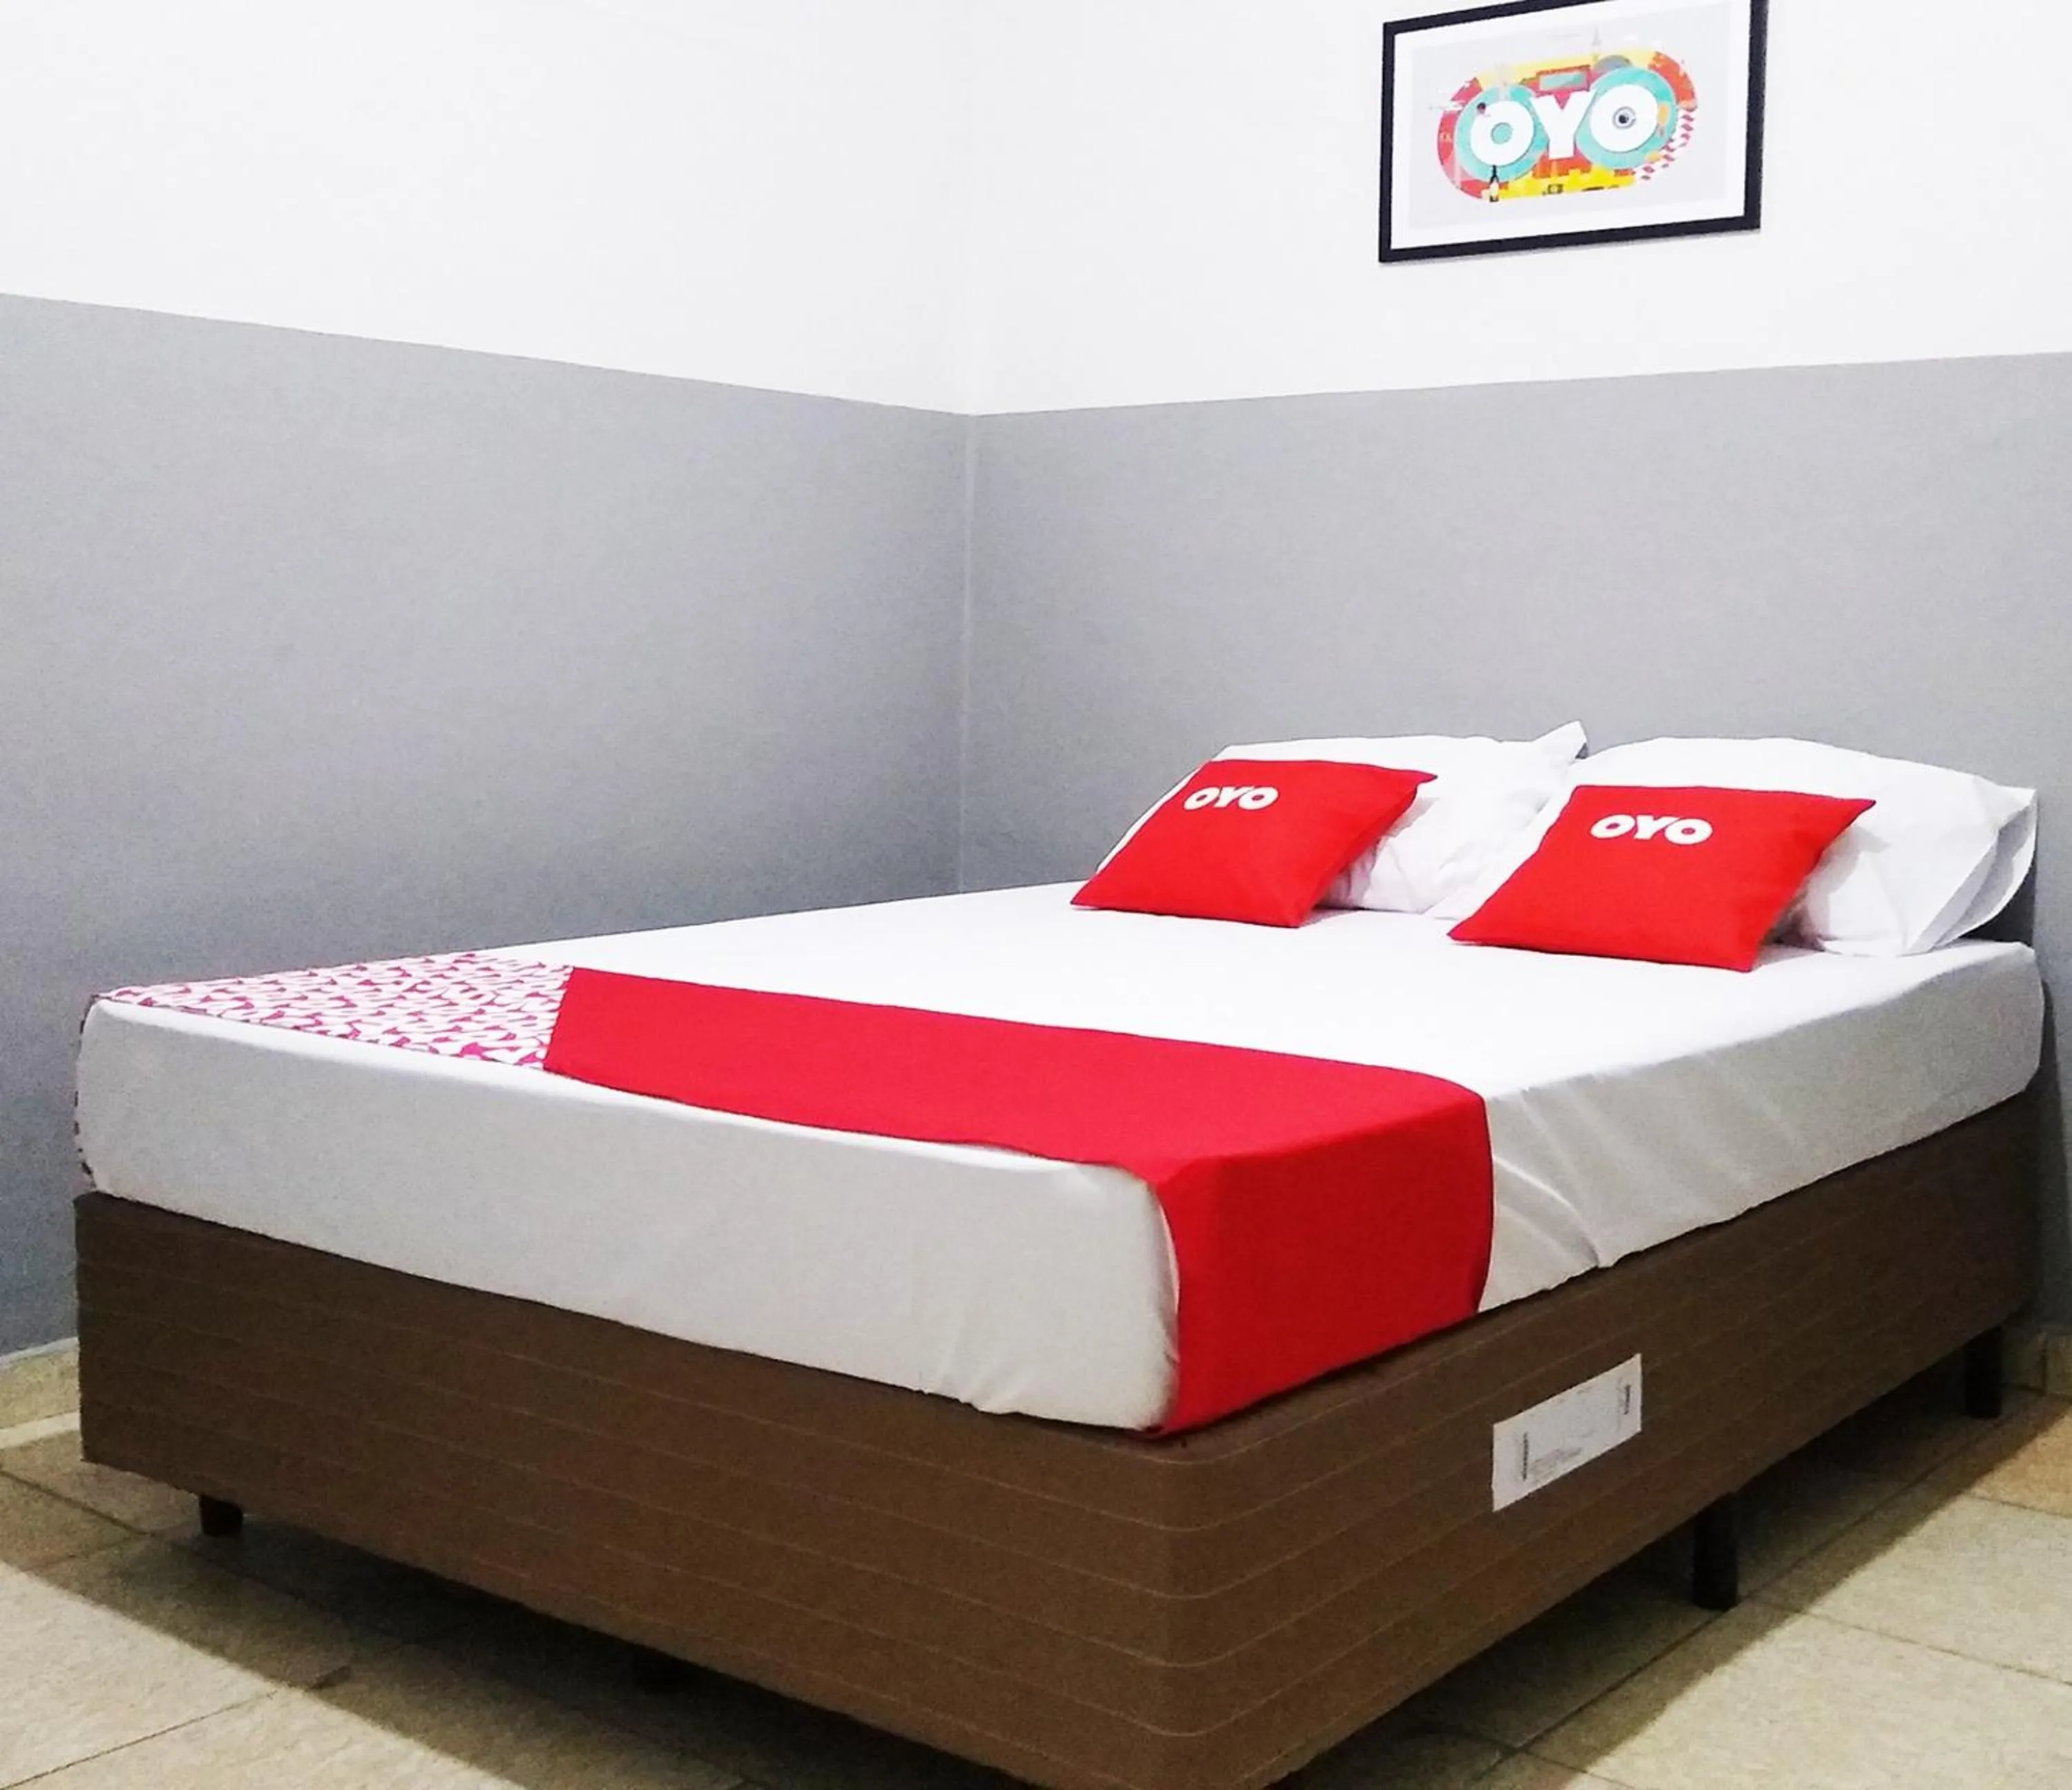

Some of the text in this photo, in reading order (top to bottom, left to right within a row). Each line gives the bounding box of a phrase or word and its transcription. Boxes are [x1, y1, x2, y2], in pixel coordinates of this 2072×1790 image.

[1470, 84, 1658, 166] OYO
[1184, 785, 1278, 811] OYO
[1591, 814, 1713, 845] OYO
